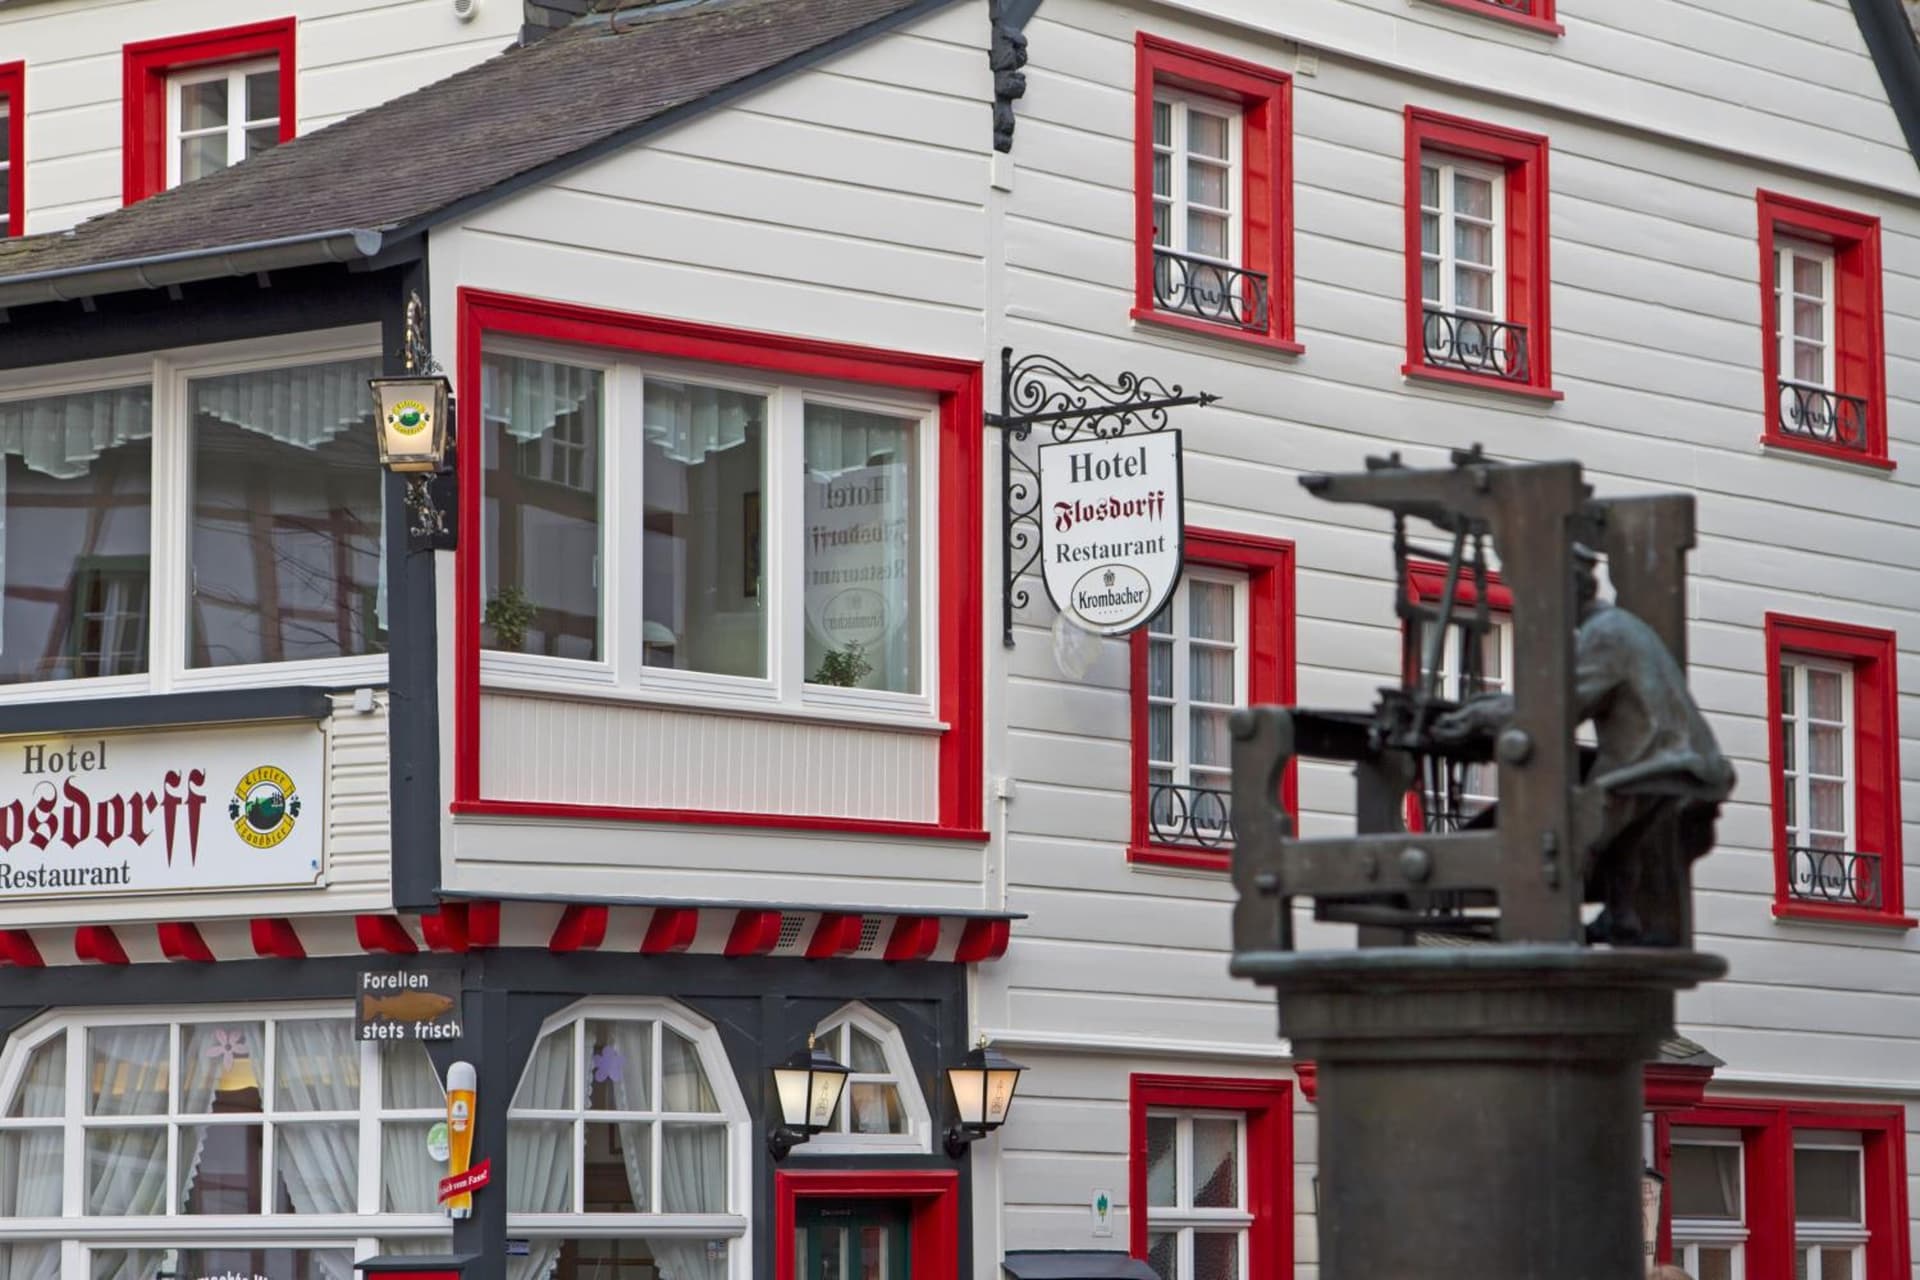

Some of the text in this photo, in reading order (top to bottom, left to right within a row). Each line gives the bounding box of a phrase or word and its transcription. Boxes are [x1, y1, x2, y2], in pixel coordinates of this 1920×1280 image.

[1069, 446, 1148, 484] Hotel
[1054, 489, 1166, 533] Flosdorff
[1056, 535, 1166, 564] Restaurant
[1079, 586, 1144, 610] Krombacher
[22, 740, 107, 774] Hotel
[0, 860, 131, 889] Restaurant
[363, 970, 429, 989] Forellen
[363, 1020, 461, 1039] stets frisch
